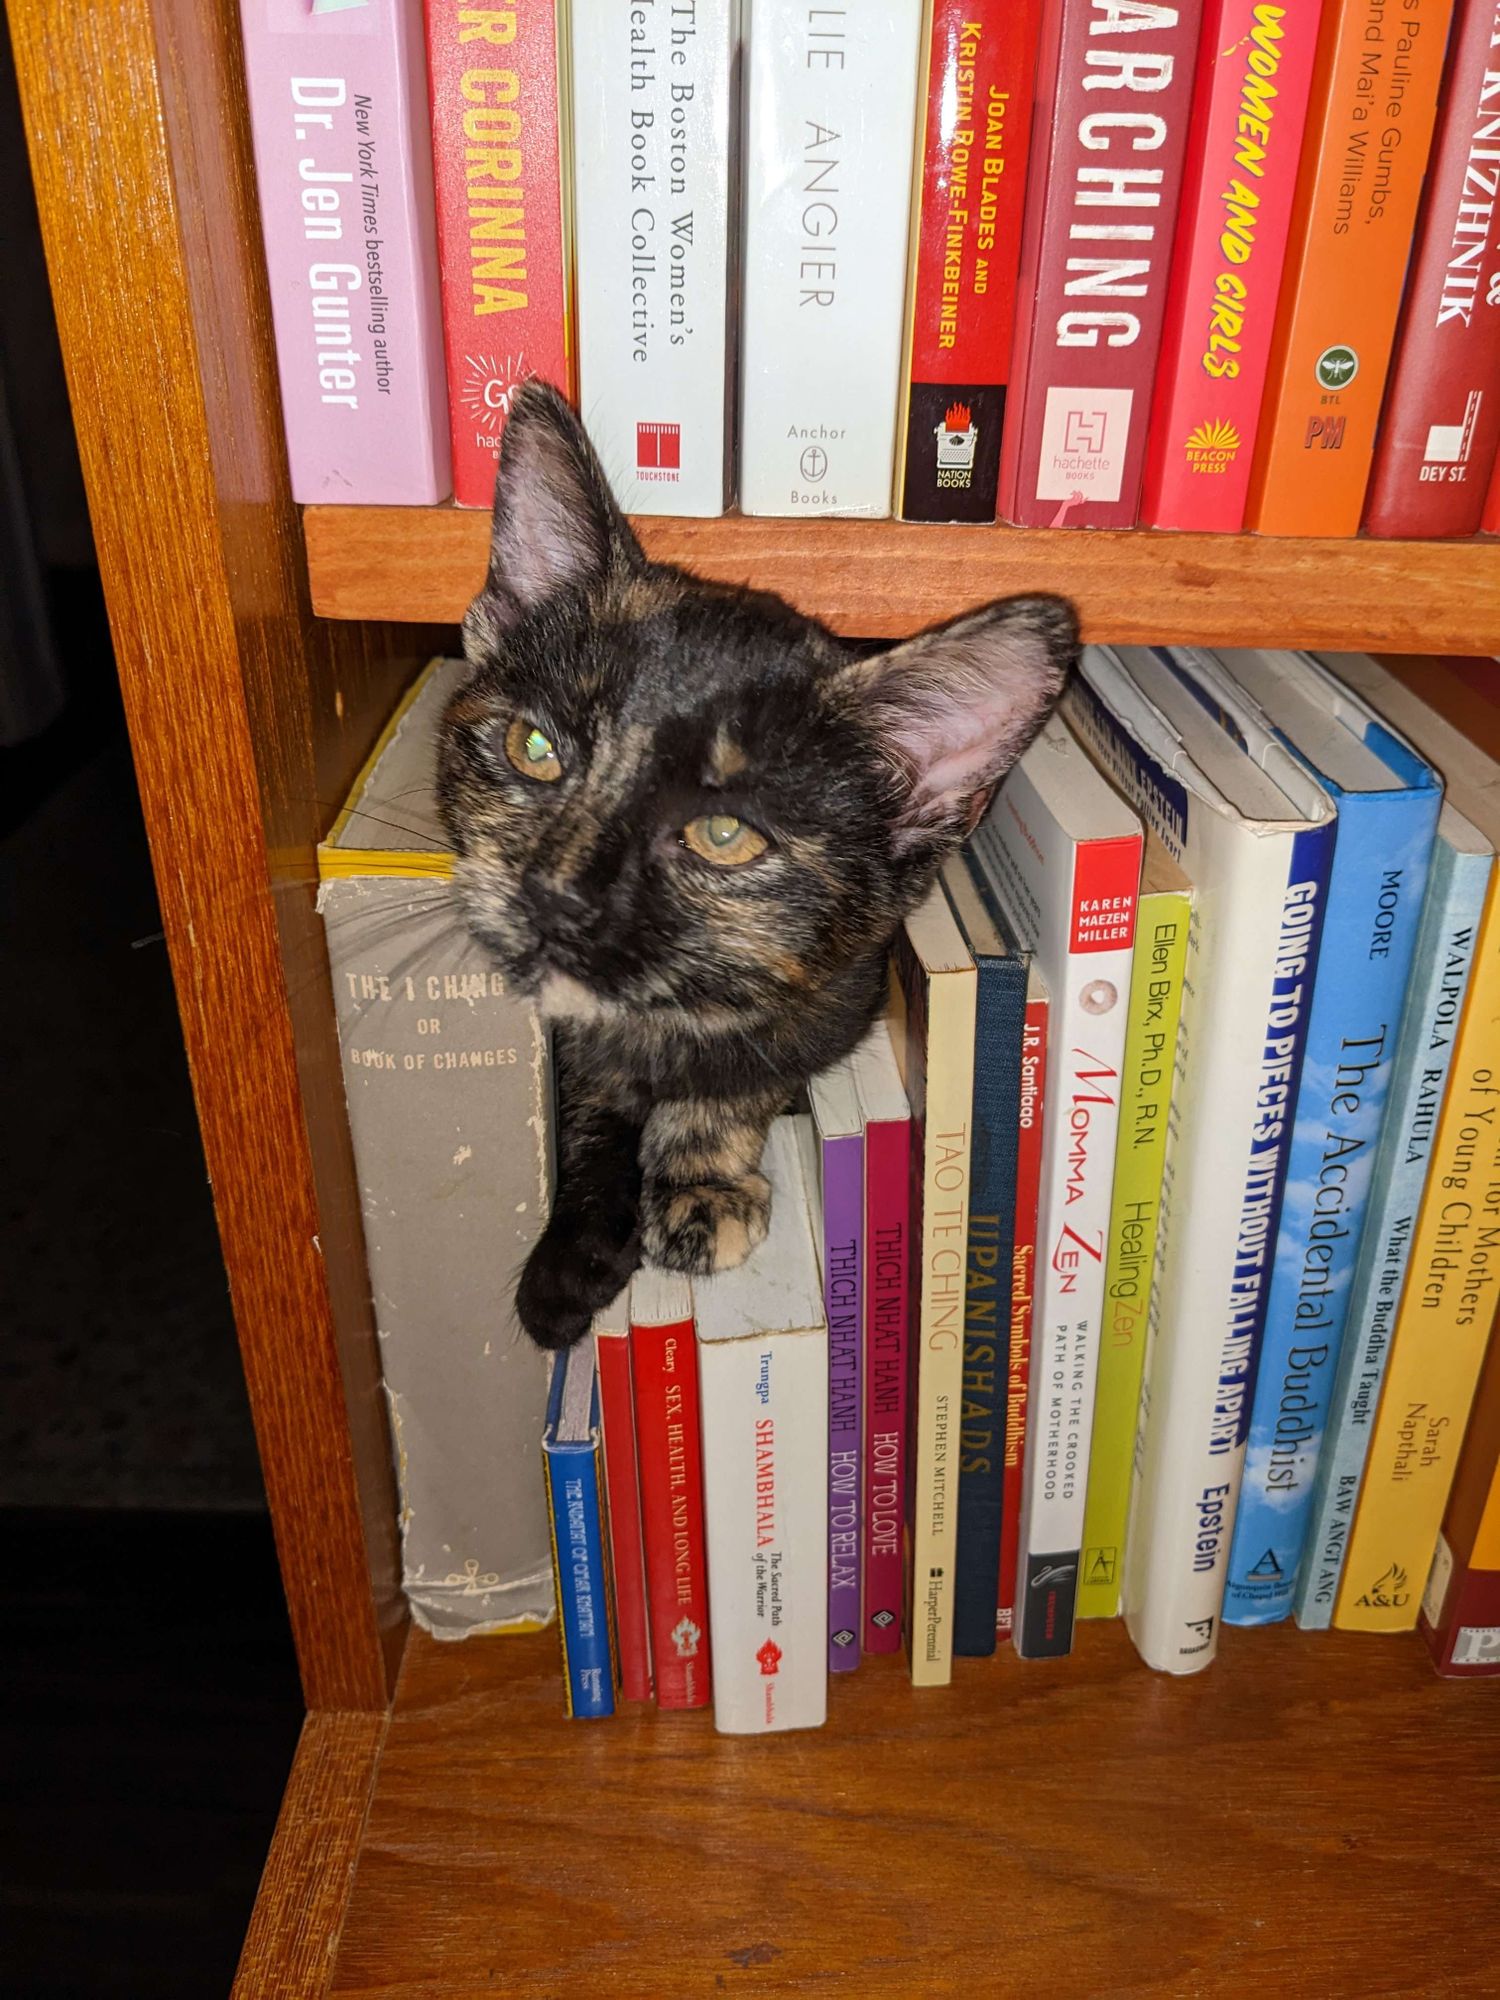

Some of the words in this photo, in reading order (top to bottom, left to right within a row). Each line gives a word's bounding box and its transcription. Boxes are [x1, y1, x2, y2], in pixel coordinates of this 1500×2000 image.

[457, 0, 518, 45] R
[670, 0, 697, 66] The
[955, 22, 983, 122] KRISTIN
[1233, 3, 1288, 179] WOMEN
[1386, 20, 1421, 120] Pauline
[290, 77, 348, 141] Dr.
[354, 94, 371, 135] New
[981, 84, 1010, 150] JOAN
[358, 135, 379, 178] York
[630, 108, 655, 193] Book
[670, 82, 696, 196] Boston
[298, 158, 353, 240] Jen
[459, 67, 529, 317] CORINNA
[977, 158, 1005, 252] BLADES
[1333, 130, 1370, 236] Williams
[1363, 127, 1402, 227] Gumbs,
[361, 179, 379, 235] Times
[799, 120, 842, 308] ANGIER
[1219, 178, 1261, 266] AND
[938, 129, 976, 350] ROWE-FINKBEINER
[364, 239, 391, 336] bestselling
[630, 206, 656, 364] Collective
[670, 210, 695, 347] Women's
[973, 259, 989, 296] AND
[309, 262, 362, 411] Gunter
[1202, 271, 1248, 381] GIRLS
[374, 337, 392, 396] author
[1319, 395, 1341, 405] BTL
[786, 424, 846, 441] Anchor
[1185, 449, 1236, 464] BEACON
[1304, 415, 1347, 450] PM
[636, 471, 681, 483] TOUCHSTONE
[936, 470, 972, 481] NATION
[936, 478, 972, 490] BOOKS
[1053, 455, 1111, 471] hachette
[1065, 471, 1095, 481] BOOKS
[1192, 462, 1227, 475] PRESS
[1419, 466, 1446, 482] DEY
[1448, 466, 1467, 483] ST.
[790, 489, 839, 506] Books
[1077, 911, 1130, 928] MAEZEN
[1079, 895, 1133, 912] KAREN
[1272, 880, 1318, 978] GOING
[1368, 870, 1404, 961] MOORE
[1077, 926, 1129, 943] MILLER
[1151, 922, 1178, 975] Ellen
[345, 972, 393, 1001] THE
[405, 976, 416, 1002] I
[427, 972, 505, 1002] CHING
[1141, 980, 1171, 1027] Birx,
[1267, 978, 1305, 1031] TO
[1428, 926, 1473, 1051] WALPOLA
[416, 1018, 441, 1035] OR
[1022, 1023, 1041, 1052] J.R.
[350, 1048, 396, 1070] BOOK
[403, 1053, 426, 1071] OF
[433, 1048, 518, 1070] CHANGES
[1135, 1032, 1166, 1099] Ph.D.,
[1329, 1024, 1388, 1117] The
[1250, 1033, 1298, 1144] PIECES
[1403, 1068, 1444, 1165] RAHULA
[1065, 1048, 1119, 1206] MOMMA
[1132, 1102, 1159, 1150] R.N.
[1441, 1106, 1496, 1191] Young
[933, 1122, 967, 1192] TAO
[932, 1200, 965, 1240] TE
[1234, 1147, 1280, 1268] WITHOUT
[1294, 1131, 1367, 1331] Accidental
[875, 1222, 903, 1290] THICH
[1052, 1221, 1104, 1294] ZEN
[1108, 1200, 1154, 1300] Healing
[1384, 1215, 1413, 1265] What
[1421, 1201, 1473, 1310] Children
[830, 1239, 857, 1308] THICH
[928, 1249, 961, 1352] CHING
[1012, 1244, 1034, 1302] Sacred
[1378, 1268, 1401, 1296] the
[831, 1313, 857, 1370] NHAT
[874, 1298, 901, 1355] NHAT
[1008, 1304, 1032, 1370] Symbols
[1055, 1324, 1068, 1363] PATH
[1111, 1298, 1144, 1349] Zen
[1218, 1268, 1263, 1383] FALLING
[1364, 1298, 1394, 1365] Buddha
[662, 1338, 678, 1373] Cleary
[754, 1351, 773, 1405] Trungpa
[1007, 1372, 1030, 1391] of
[1052, 1370, 1065, 1390] OF
[1071, 1320, 1089, 1391] WALKING
[665, 1384, 682, 1420] SEX,
[831, 1378, 857, 1433] HANH
[873, 1359, 900, 1414] HANH
[1068, 1398, 1081, 1427] THE
[1350, 1368, 1380, 1426] Taught
[934, 1395, 949, 1463] STEPHEN
[1003, 1392, 1028, 1467] Buddhism
[1208, 1382, 1246, 1456] APART
[1264, 1343, 1329, 1493] Buddhist
[1391, 1402, 1429, 1483] Napthali
[1419, 1416, 1450, 1468] Sarah
[831, 1449, 857, 1496] HOW
[873, 1431, 898, 1477] HOW
[1043, 1398, 1062, 1501] MOTHERHOOD
[1062, 1433, 1079, 1500] CROOKED
[672, 1494, 689, 1527] AND
[756, 1418, 776, 1549] SHAMBHALA
[872, 1480, 898, 1508] TO
[931, 1466, 947, 1537] MITCHELL
[831, 1500, 857, 1528] TO
[872, 1508, 897, 1557] LOVE
[1192, 1482, 1231, 1573] Epstein
[674, 1527, 692, 1574] LONG
[756, 1564, 767, 1580] the
[771, 1551, 782, 1569] The
[831, 1532, 857, 1590] RELAX
[676, 1573, 693, 1606] LIFE
[756, 1581, 768, 1618] Warrior
[771, 1571, 782, 1602] Sacred
[1353, 1594, 1411, 1608] A&U
[772, 1605, 783, 1626] Path
[925, 1580, 945, 1663] HarperPerennial
